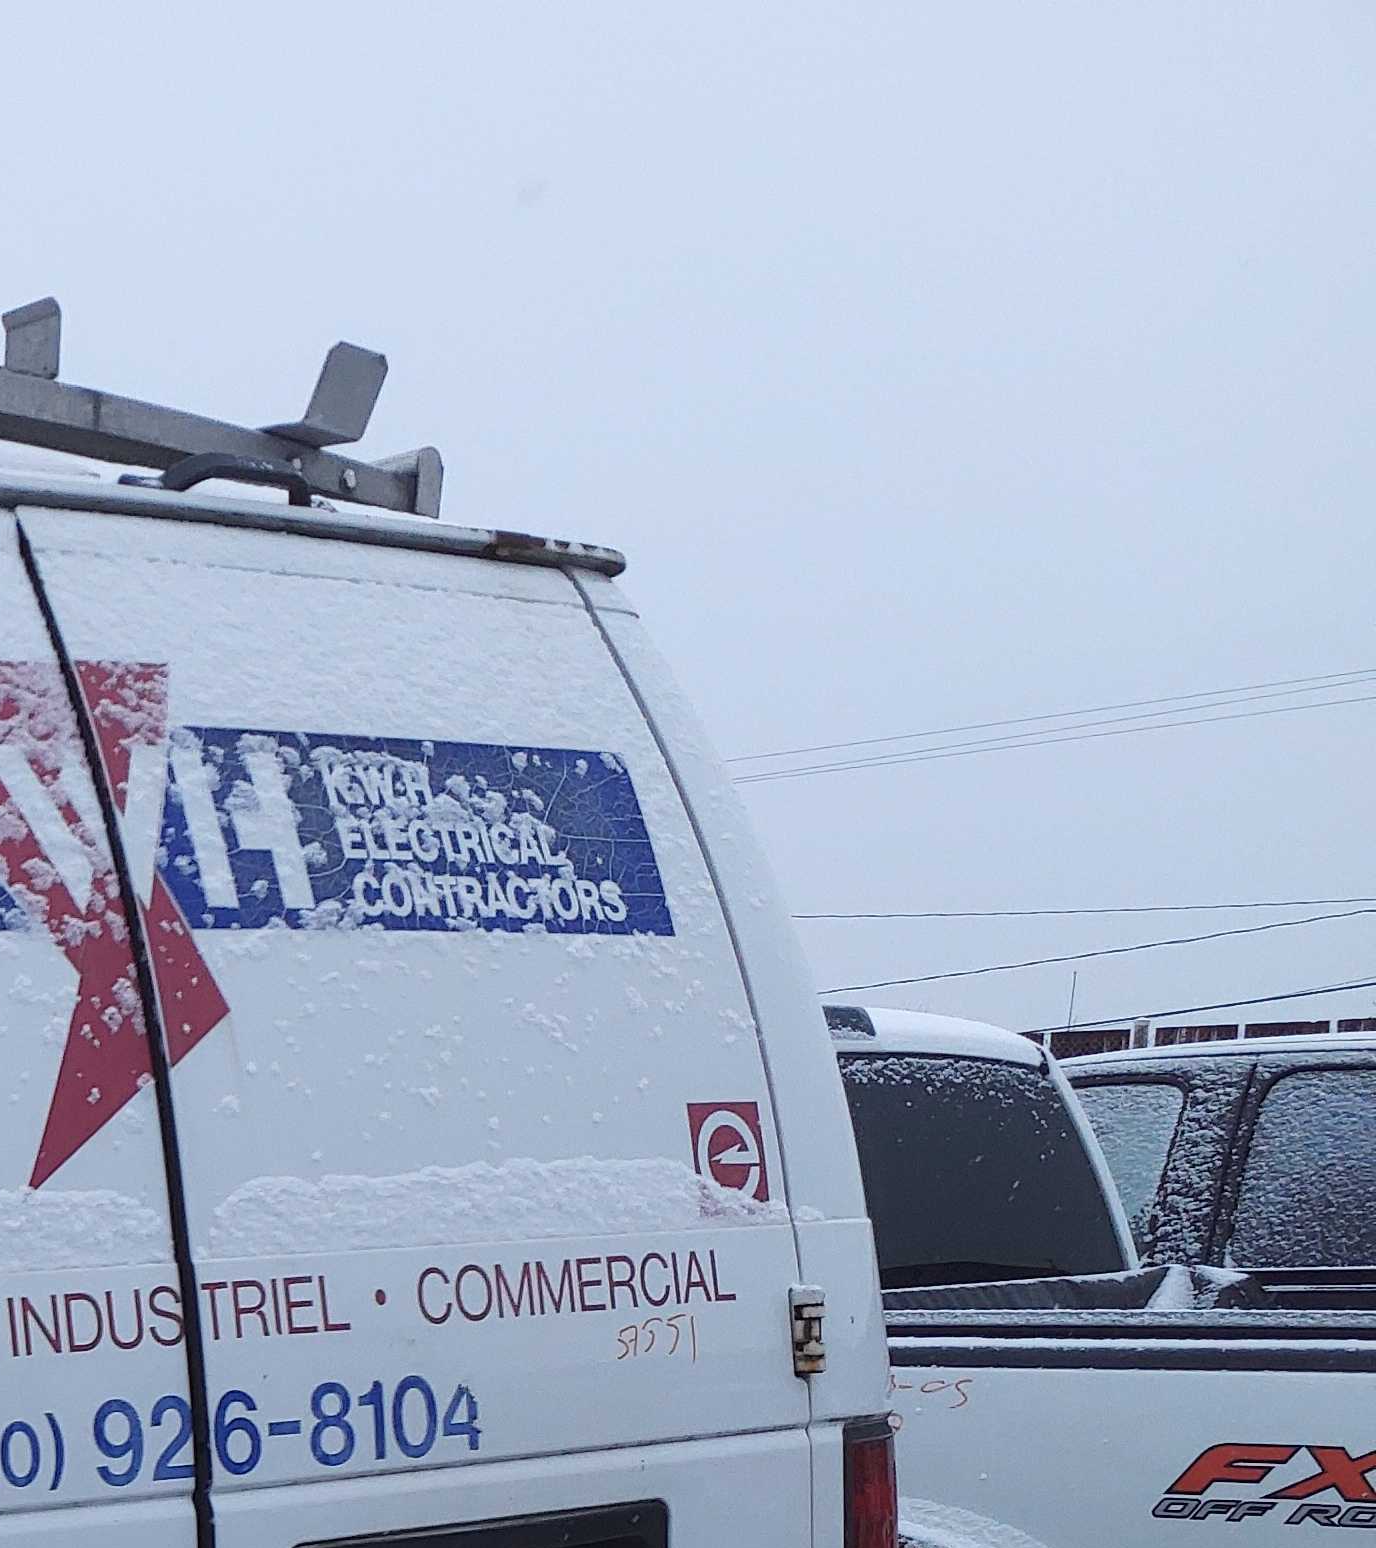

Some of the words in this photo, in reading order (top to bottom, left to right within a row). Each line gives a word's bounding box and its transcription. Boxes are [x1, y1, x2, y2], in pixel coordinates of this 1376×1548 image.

[335, 813, 570, 868] ELECTRICAL
[351, 866, 628, 923] CONTRACTORS
[6, 1275, 351, 1357] INDUSTRIEL
[416, 1248, 737, 1326] COMMERCIAL
[93, 1374, 481, 1487] 926-8104
[1151, 1497, 1279, 1523] OFF
